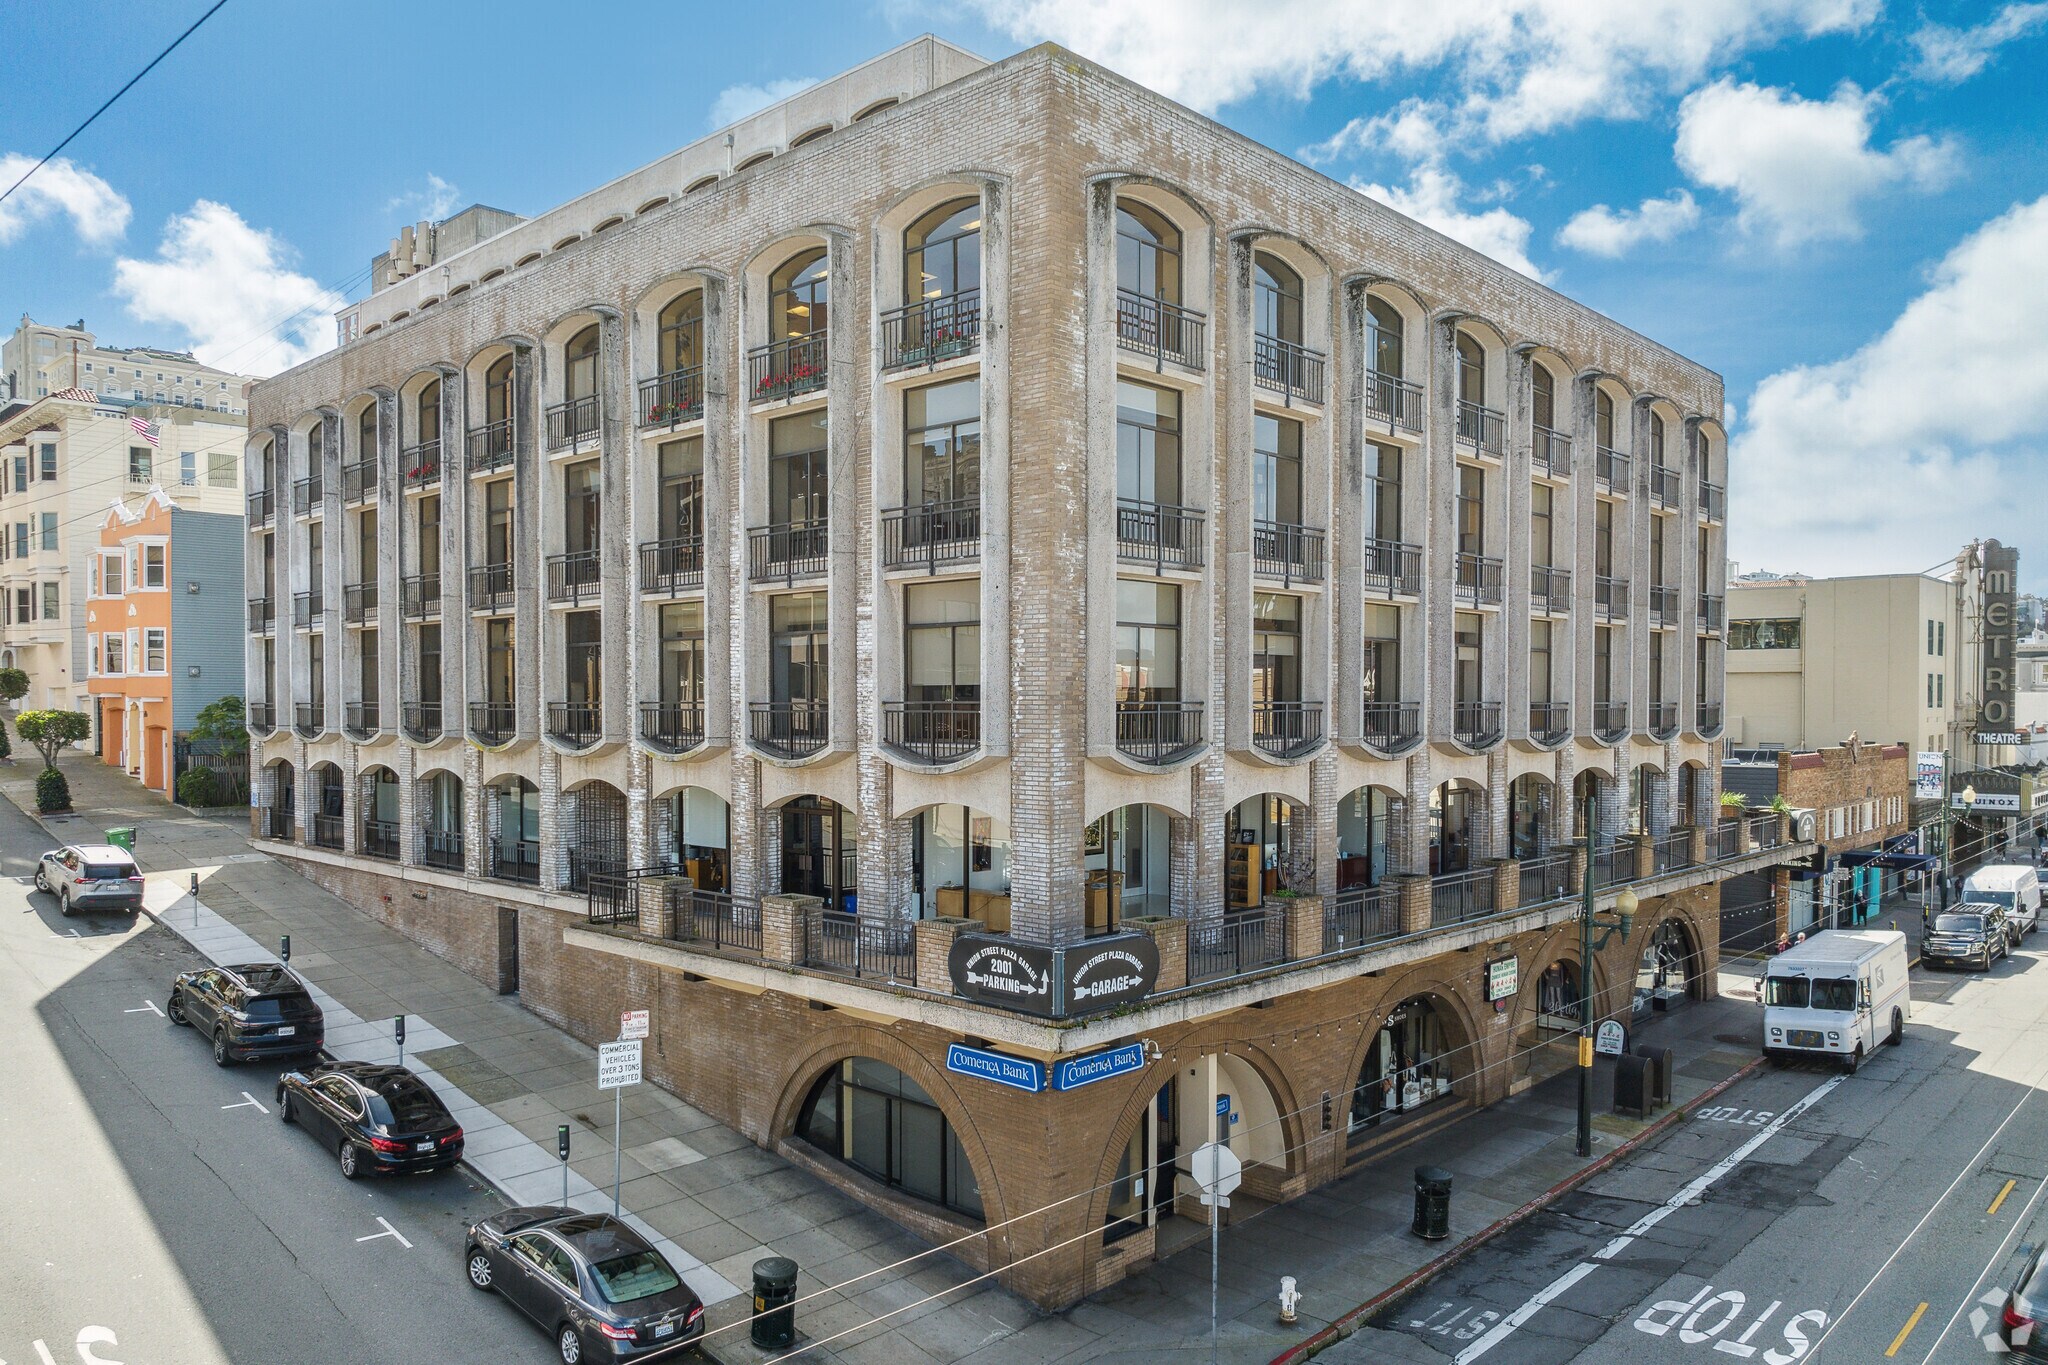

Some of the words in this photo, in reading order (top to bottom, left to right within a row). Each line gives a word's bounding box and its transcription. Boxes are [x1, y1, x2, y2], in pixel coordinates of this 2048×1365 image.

[1984, 569, 2010, 723] METRO
[1978, 733, 2022, 744] THEATRE
[1957, 797, 2015, 806] EUINOX
[966, 952, 981, 969] UNION
[981, 946, 999, 957] STREET
[1001, 947, 1017, 961] PLAZA
[1018, 956, 1038, 982] GARAGE
[991, 958, 1012, 975] 2001
[1072, 963, 1089, 985] UNION
[1088, 952, 1108, 968] STREET
[1108, 950, 1125, 960] PLAZA
[1125, 952, 1144, 972] GARAGE
[983, 974, 1020, 993] PARKING
[1091, 975, 1129, 997] GARAGE
[601, 1044, 640, 1055] COMMERCIAL
[605, 1054, 636, 1064] VEHICLES
[1114, 1050, 1137, 1067] Bank
[601, 1066, 617, 1075] OVER
[618, 1065, 623, 1073] 3
[625, 1063, 640, 1071] TONS
[1003, 1063, 1029, 1081] Bank
[601, 1074, 639, 1085] PROHIBITED
[1695, 1105, 1774, 1126] STOP
[1633, 1285, 1830, 1365] STOP
